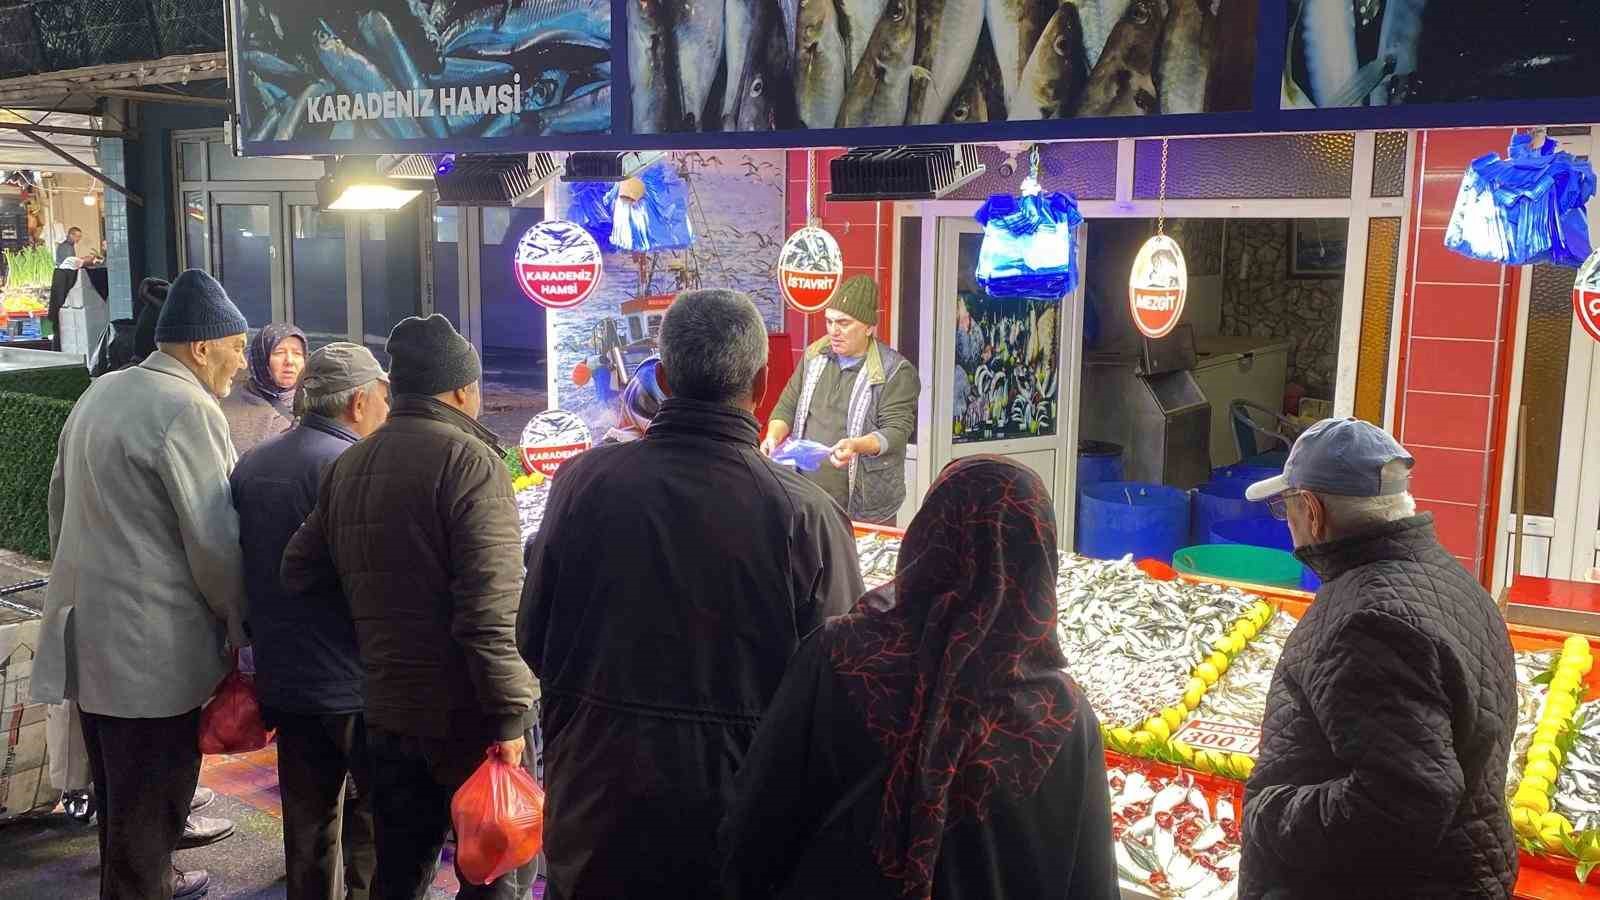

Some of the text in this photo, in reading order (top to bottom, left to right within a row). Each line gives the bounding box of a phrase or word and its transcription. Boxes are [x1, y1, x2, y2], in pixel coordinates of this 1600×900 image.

[439, 73, 521, 116] HAMSİ
[526, 269, 593, 281] KARADENİZ
[788, 272, 835, 290] İSTAVRİT
[541, 283, 578, 295] HAMSİ
[1136, 292, 1177, 311] MEZGİT
[1182, 731, 1236, 747] 300
